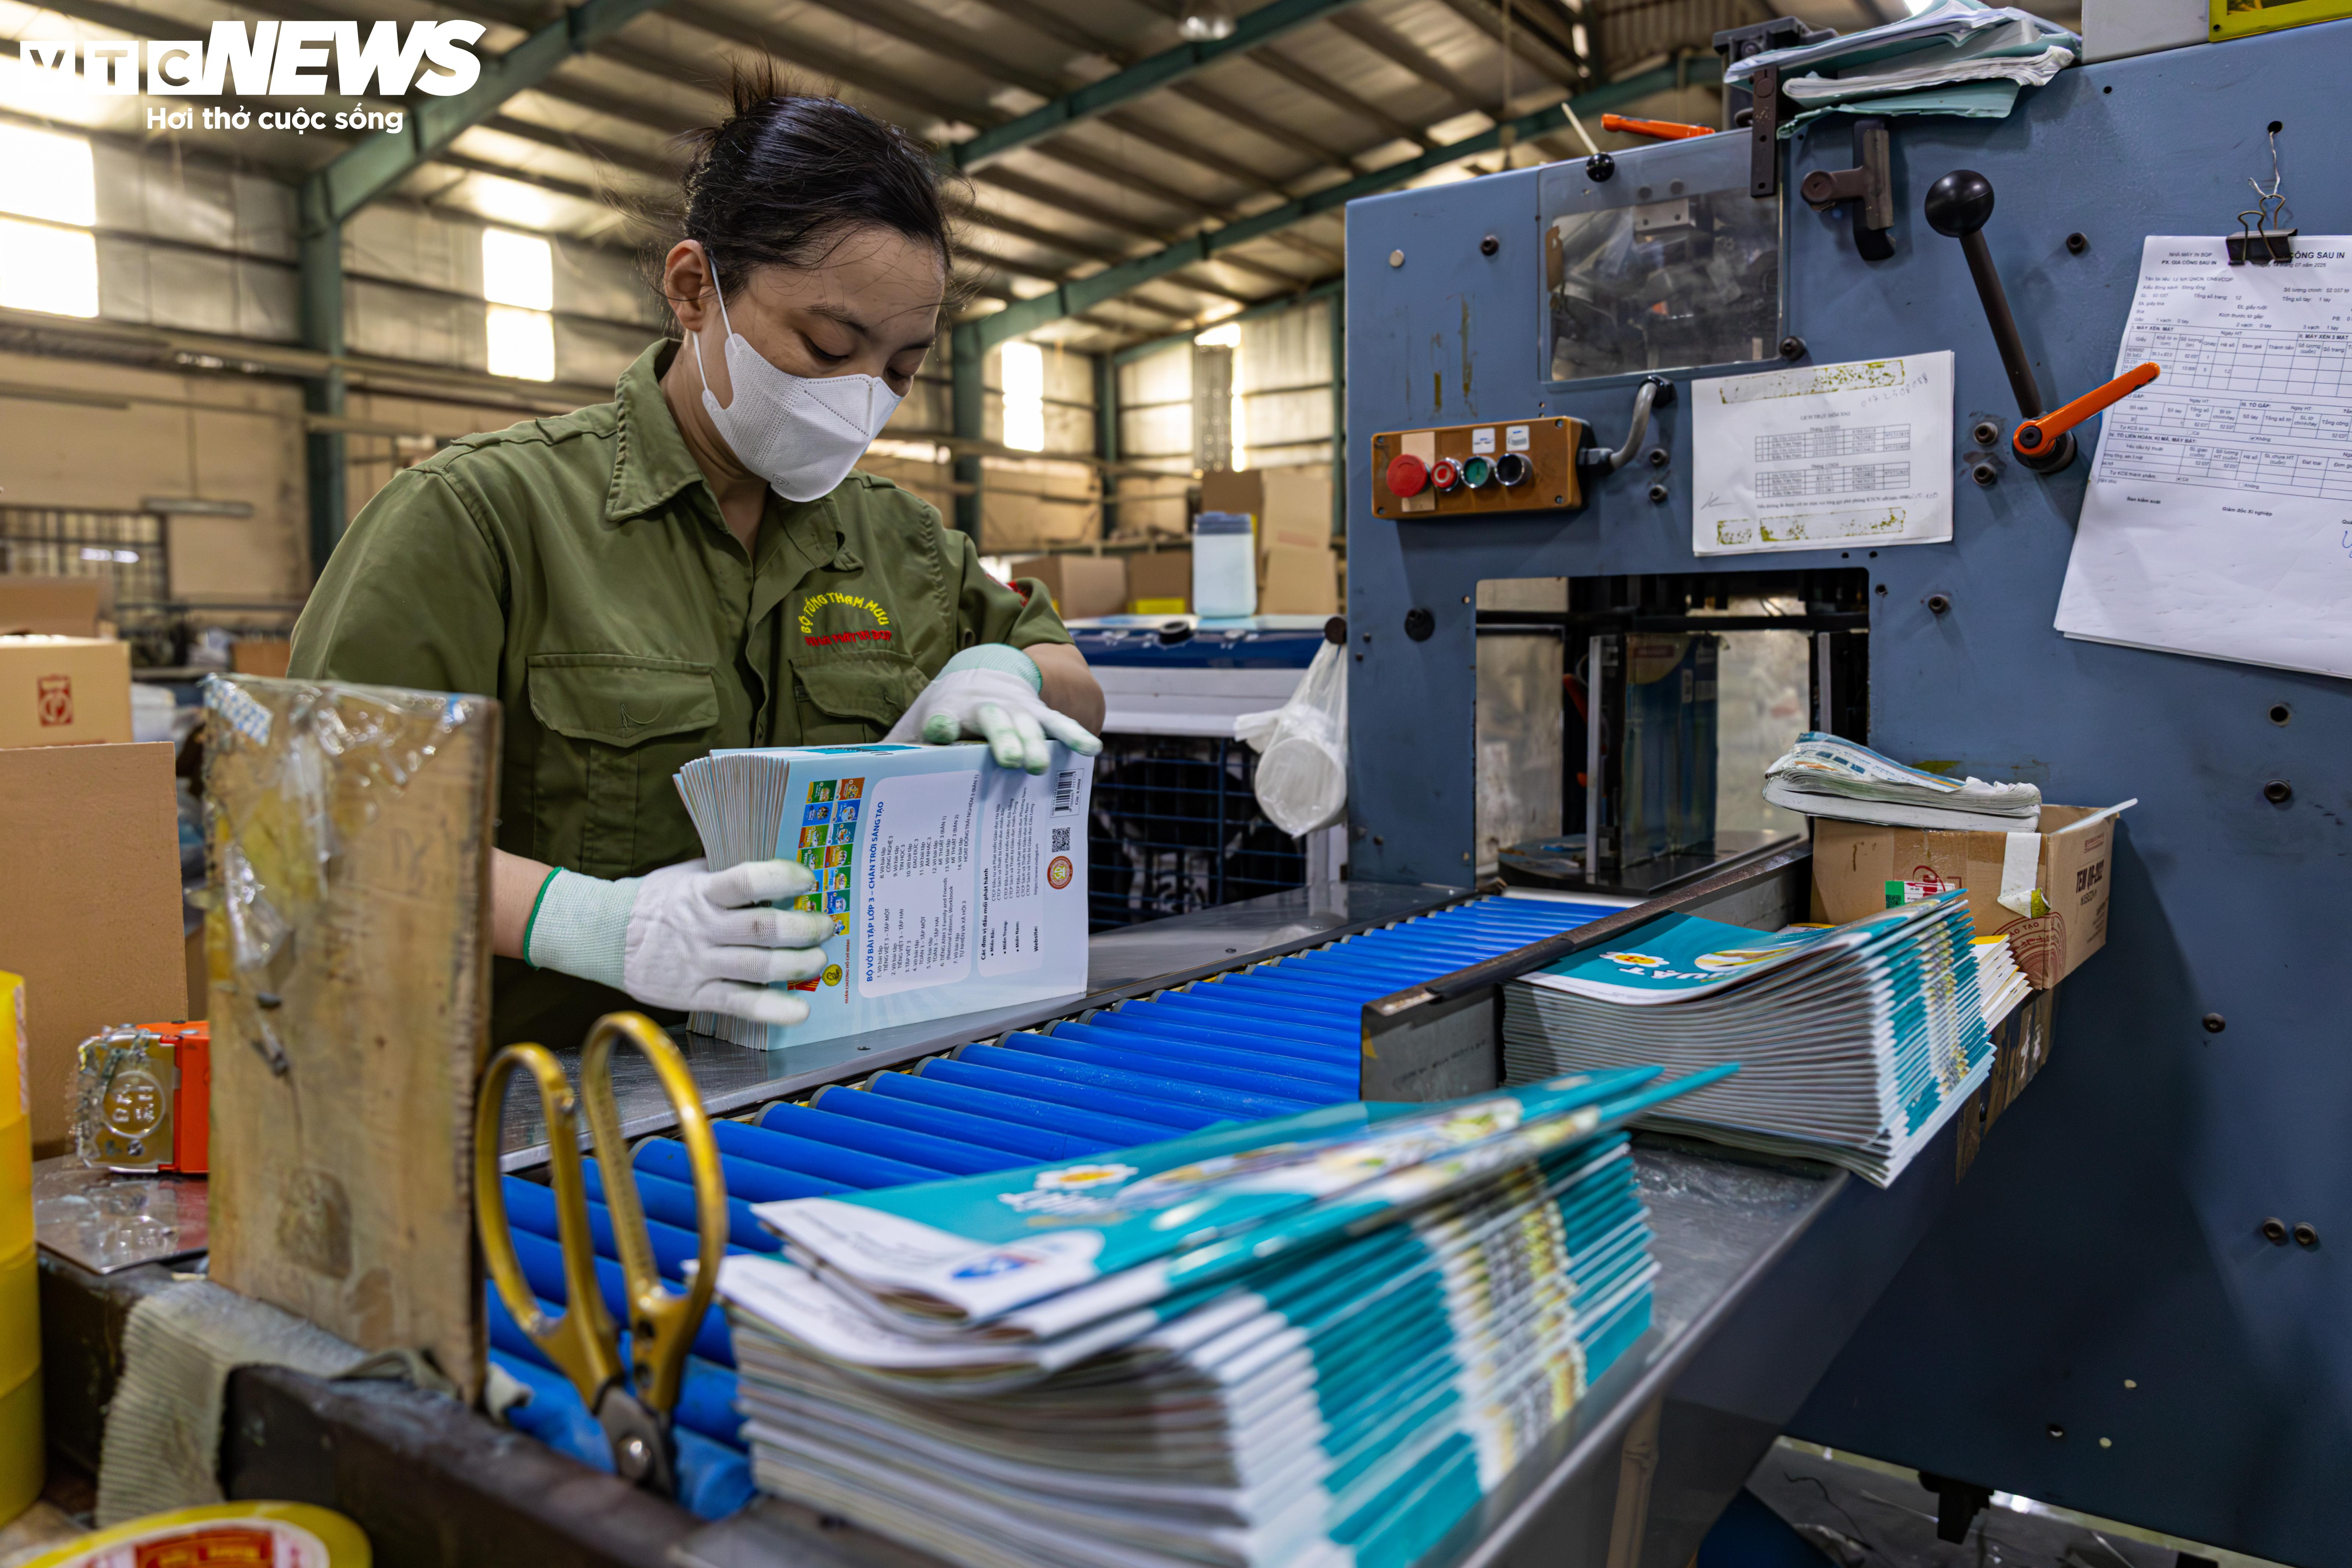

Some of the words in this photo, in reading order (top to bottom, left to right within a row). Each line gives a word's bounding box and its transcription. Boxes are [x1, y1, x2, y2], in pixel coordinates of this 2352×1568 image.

[876, 802, 884, 818] TẠO
[872, 819, 880, 841] SÁNG
[925, 858, 930, 866] ÂM
[867, 923, 875, 938] TẬP
[2022, 922, 2039, 930] TẠO
[866, 956, 873, 969] VỞ
[866, 970, 874, 982] BỘ
